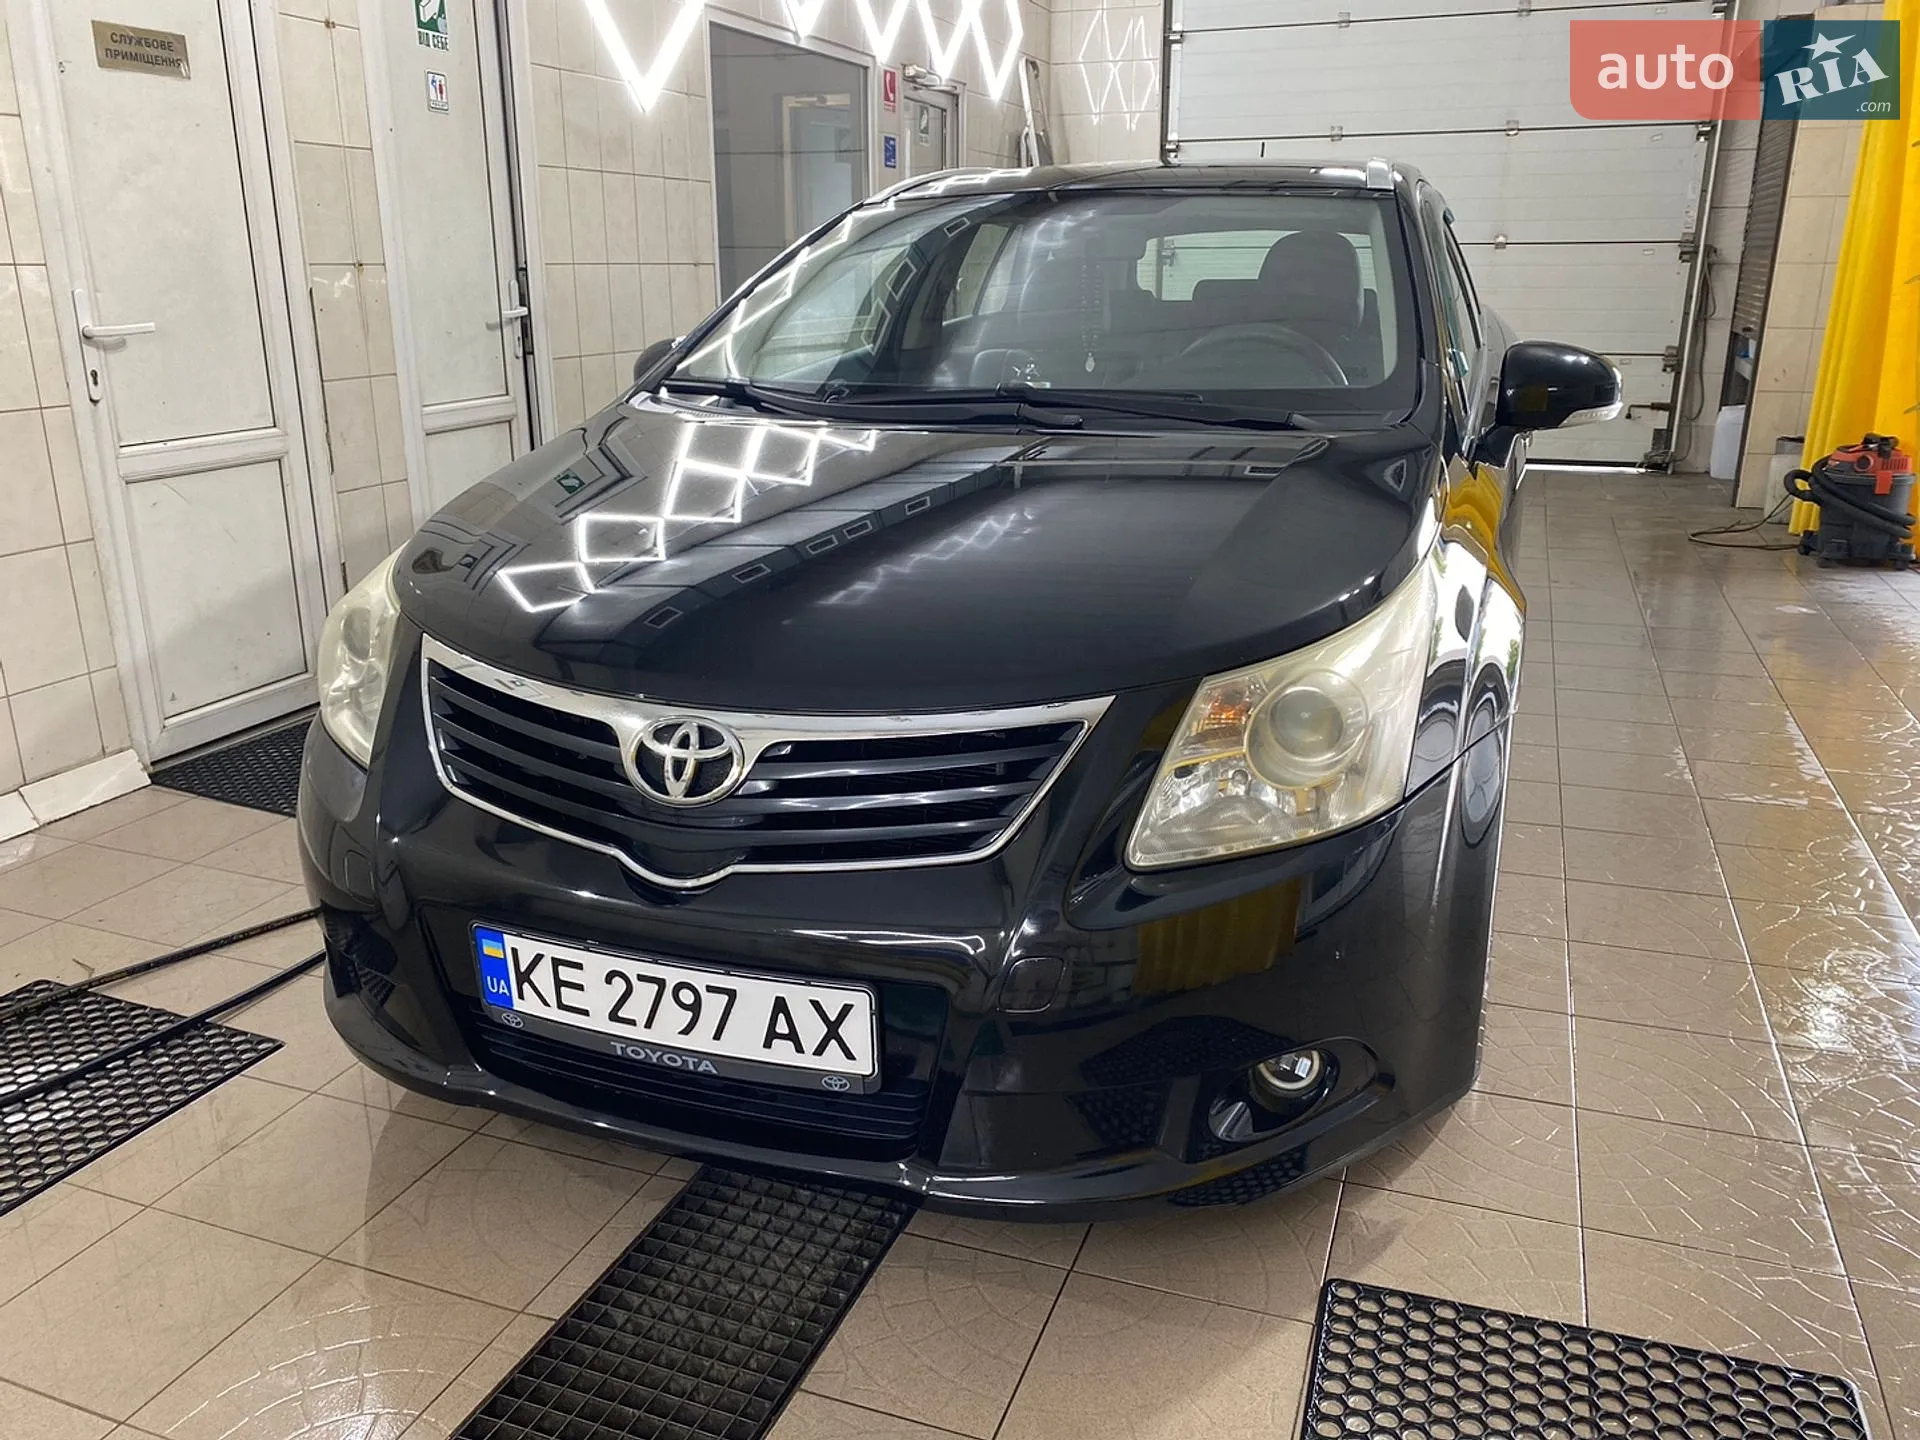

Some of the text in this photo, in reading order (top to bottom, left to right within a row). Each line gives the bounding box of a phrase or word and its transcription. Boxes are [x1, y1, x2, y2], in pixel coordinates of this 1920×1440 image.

[110, 31, 174, 52] СЛУЖБОВЕ
[104, 47, 182, 68] ПРИМІЩЕННЯ
[486, 975, 510, 996] UA
[511, 946, 857, 1061] KE 2797 AX
[610, 1041, 718, 1074] TOYOTA
